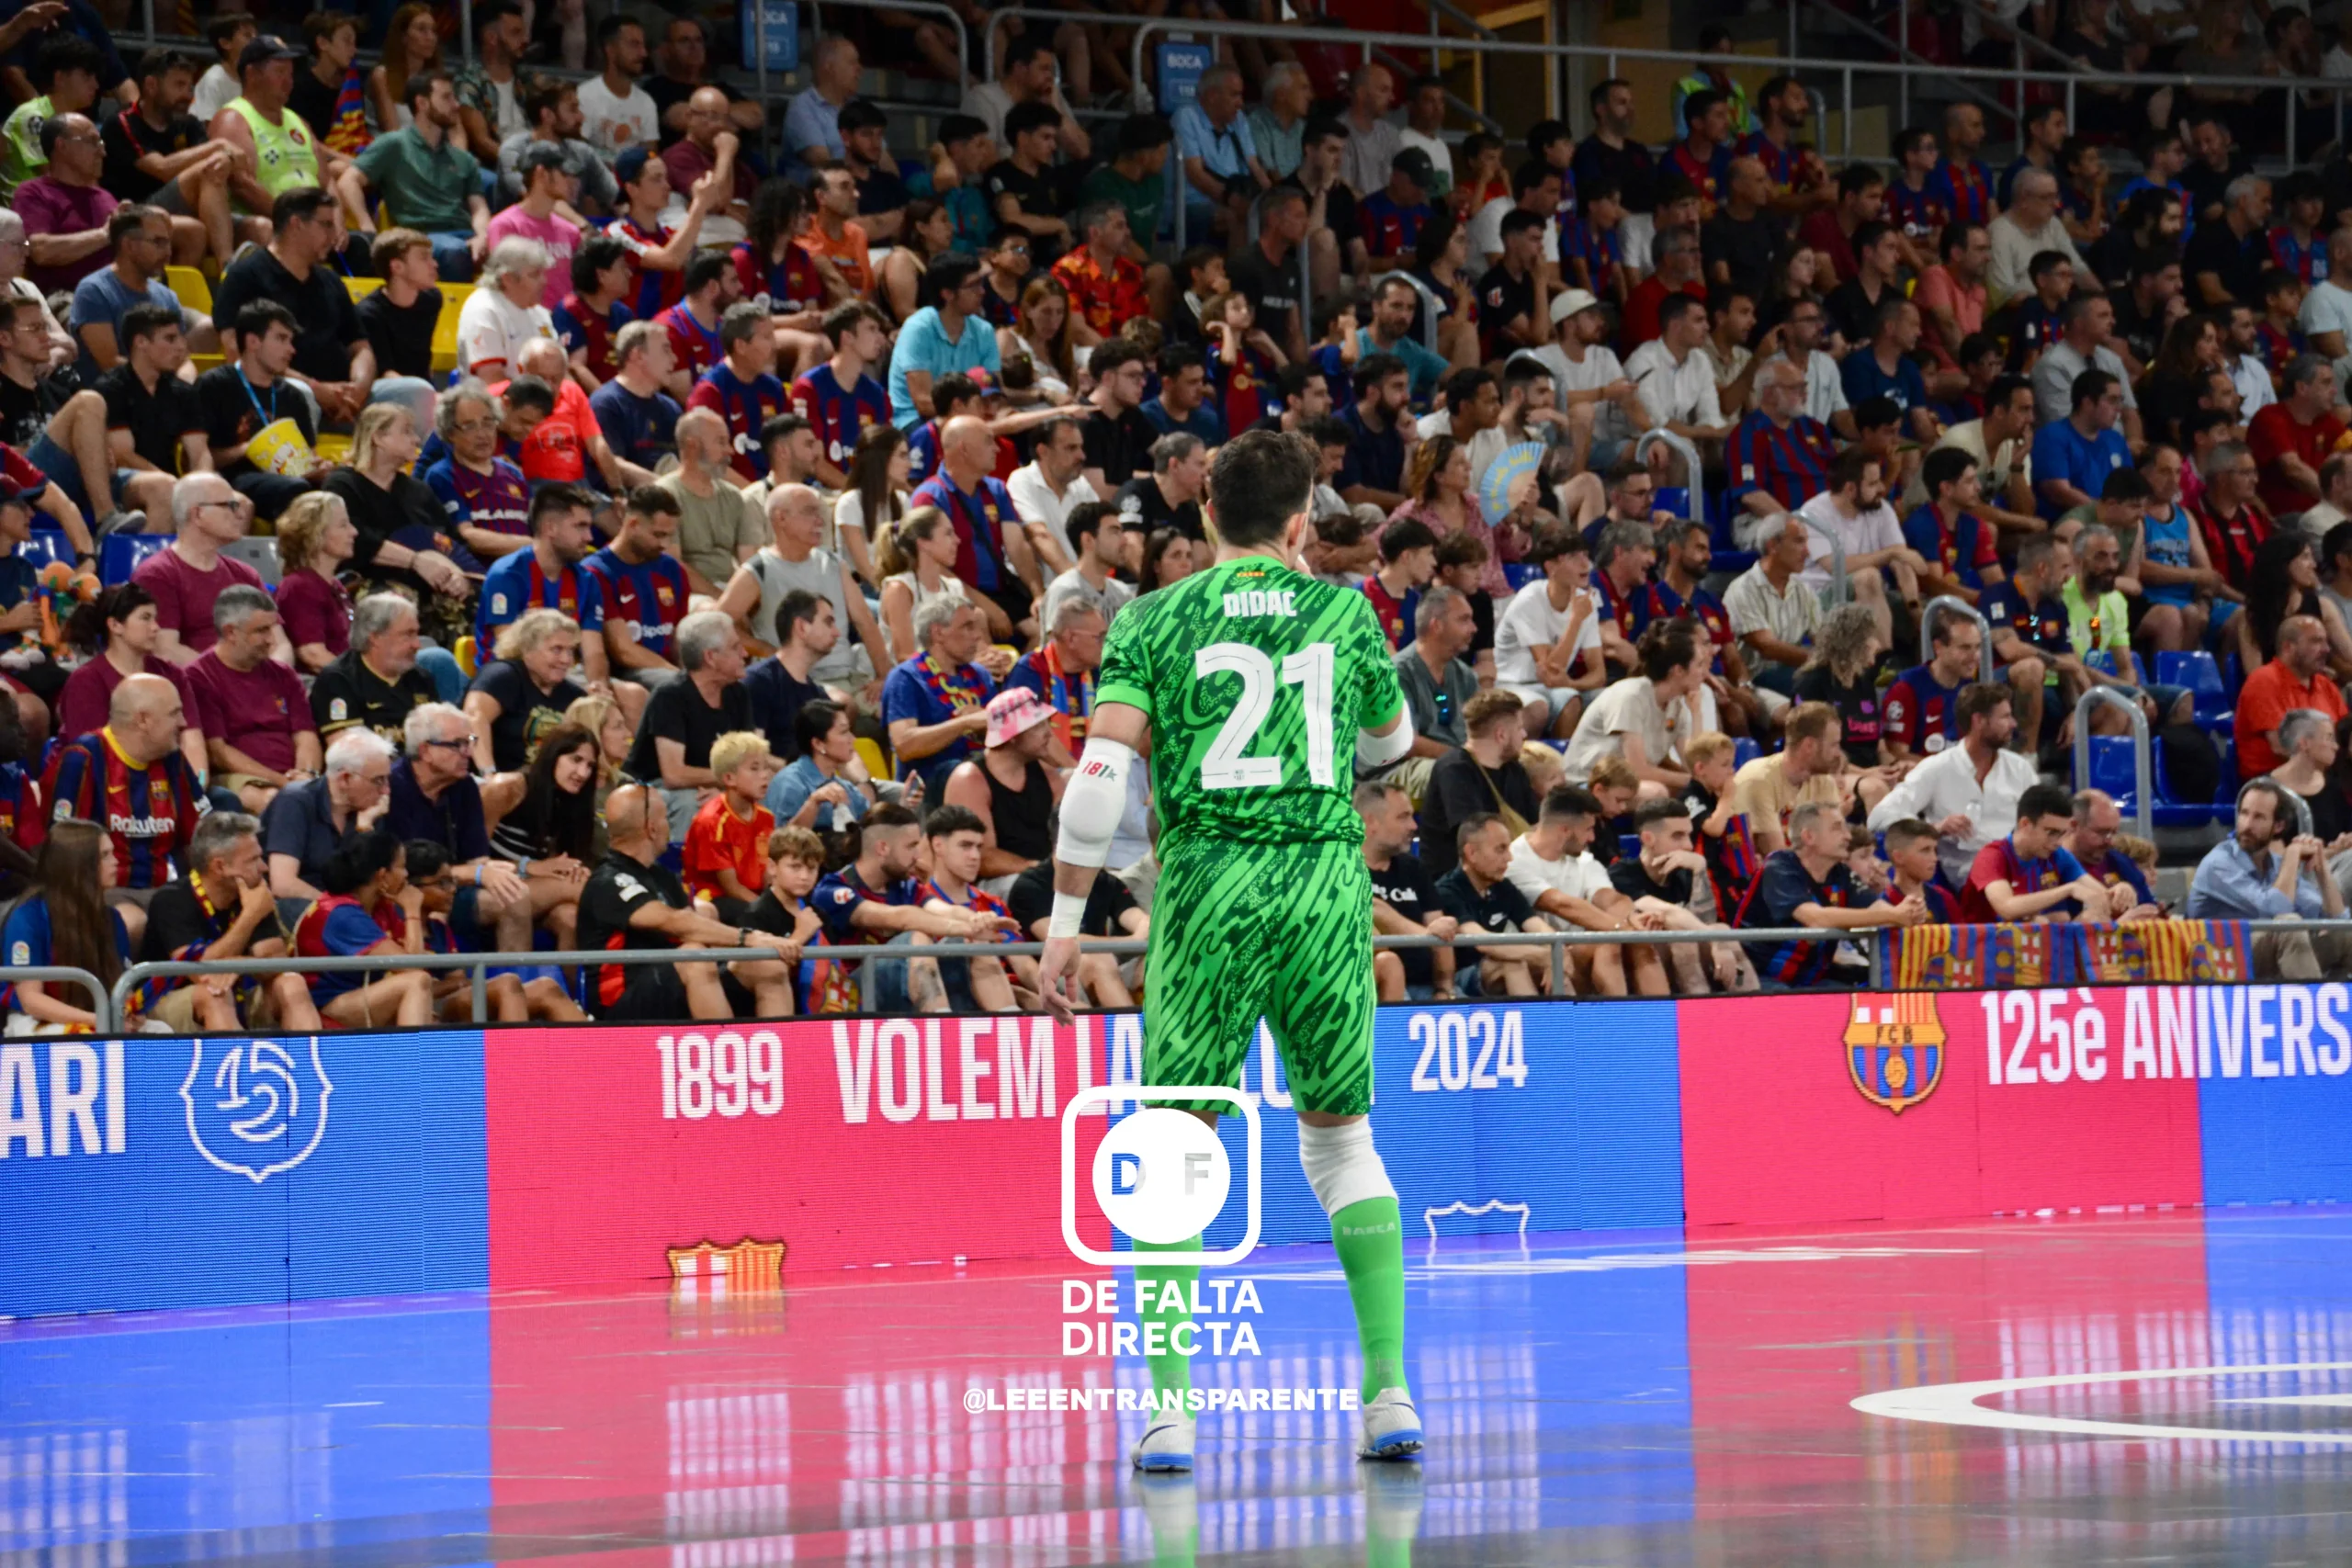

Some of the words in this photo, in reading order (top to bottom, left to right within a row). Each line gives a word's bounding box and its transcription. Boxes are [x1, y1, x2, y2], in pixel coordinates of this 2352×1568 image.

[1167, 53, 1203, 69] BOCA
[1223, 591, 1297, 617] DIDAC
[1195, 642, 1335, 789] 21
[110, 813, 175, 834] Rakuten
[656, 1030, 785, 1119] 1899
[832, 1015, 1057, 1123] VOLEM
[1409, 1010, 1528, 1091] 2024
[1980, 987, 2107, 1086] 125è
[2122, 983, 2350, 1080] ANIVERS
